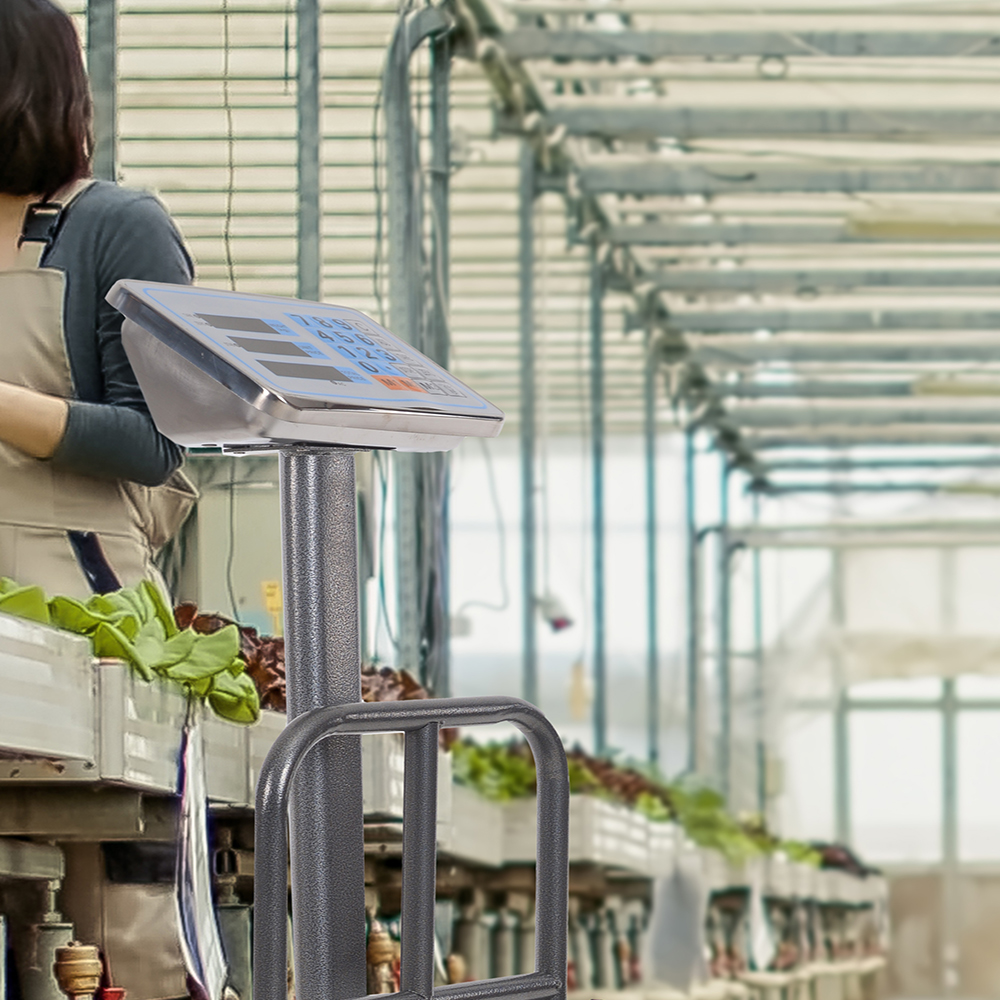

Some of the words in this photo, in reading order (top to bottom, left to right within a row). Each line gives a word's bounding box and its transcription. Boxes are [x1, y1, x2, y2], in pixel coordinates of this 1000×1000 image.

[290, 314, 310, 326] 7
[311, 316, 333, 328] 8
[331, 318, 353, 330] 9
[317, 330, 335, 342] 4
[333, 331, 355, 343] 5
[355, 333, 375, 346] 6
[337, 345, 357, 358] 1
[356, 347, 379, 360] 2
[376, 348, 397, 361] 3
[358, 361, 379, 373] 0
